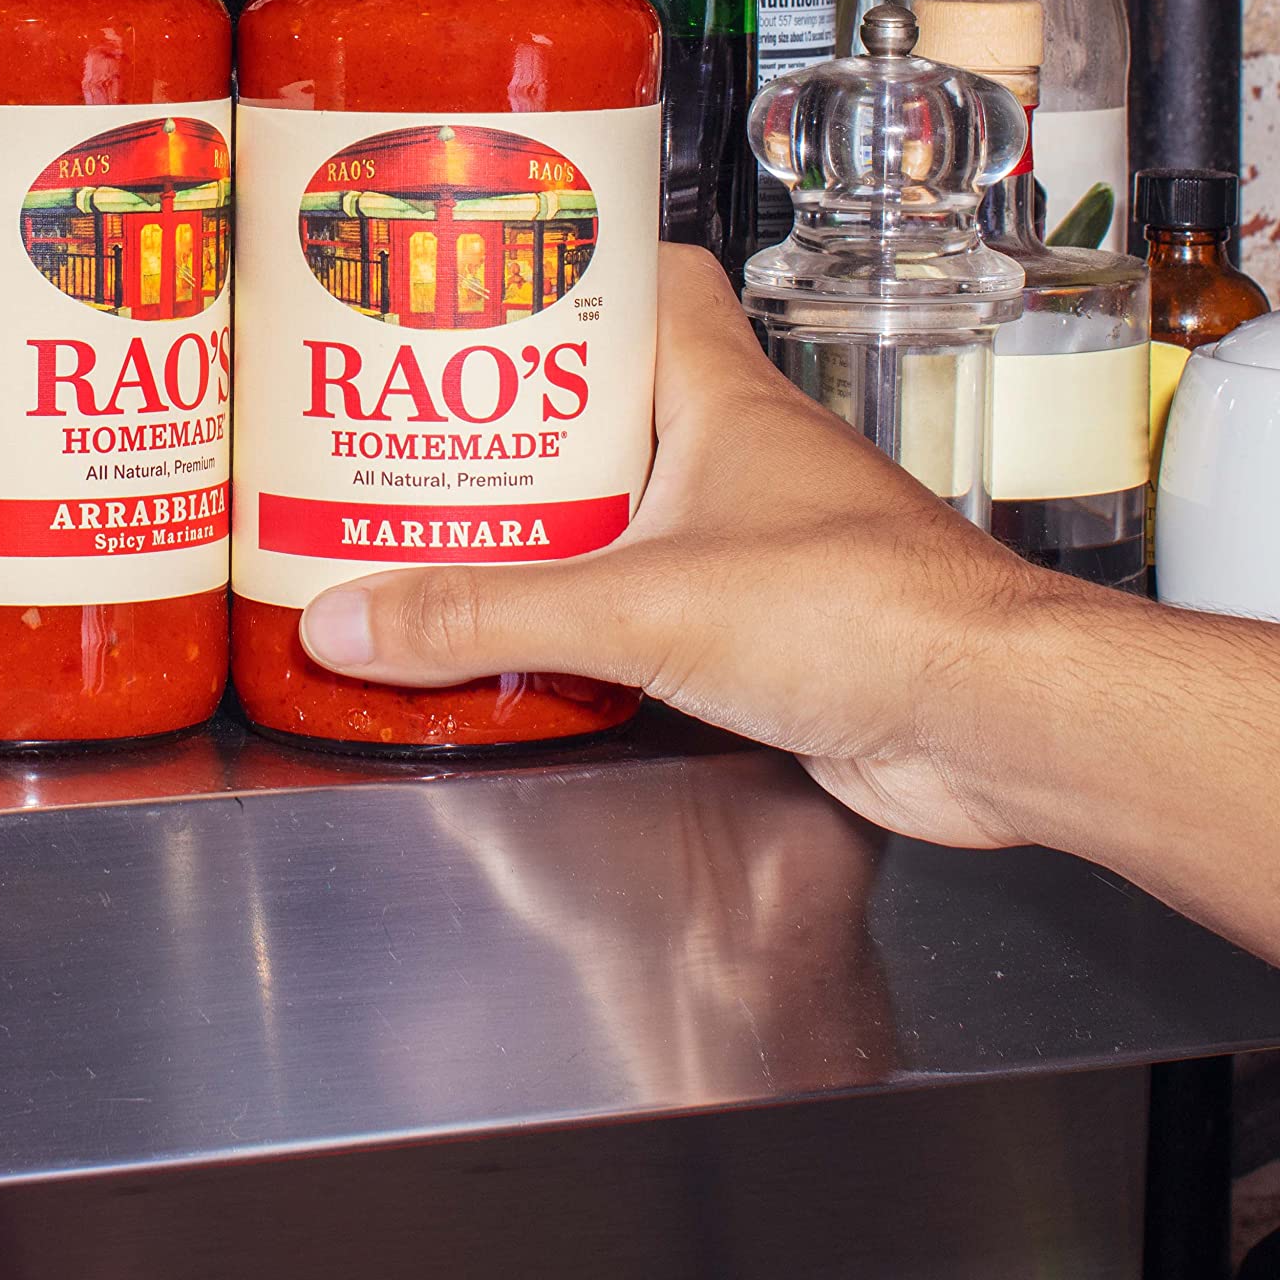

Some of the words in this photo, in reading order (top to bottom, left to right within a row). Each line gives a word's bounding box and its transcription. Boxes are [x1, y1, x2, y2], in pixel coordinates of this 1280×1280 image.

[778, 14, 793, 28] 557
[778, 31, 790, 44] size
[58, 153, 111, 179] RAO'S
[327, 159, 376, 182] RAO'S
[527, 159, 575, 183] RAO'S
[573, 296, 604, 309] SINCE
[577, 310, 601, 322] 1896
[26, 327, 230, 417] RAO'S
[302, 340, 590, 424] RAO'S
[85, 465, 108, 481] All
[114, 460, 170, 480] Natural,
[174, 456, 216, 475] Premium
[352, 470, 376, 486] All
[380, 470, 451, 489] Natural,
[457, 470, 535, 487] Premium
[50, 488, 226, 531] ARRABBIATA
[94, 531, 145, 553] Spicy
[152, 525, 214, 547] Marinara
[341, 517, 551, 548] MARINARA
